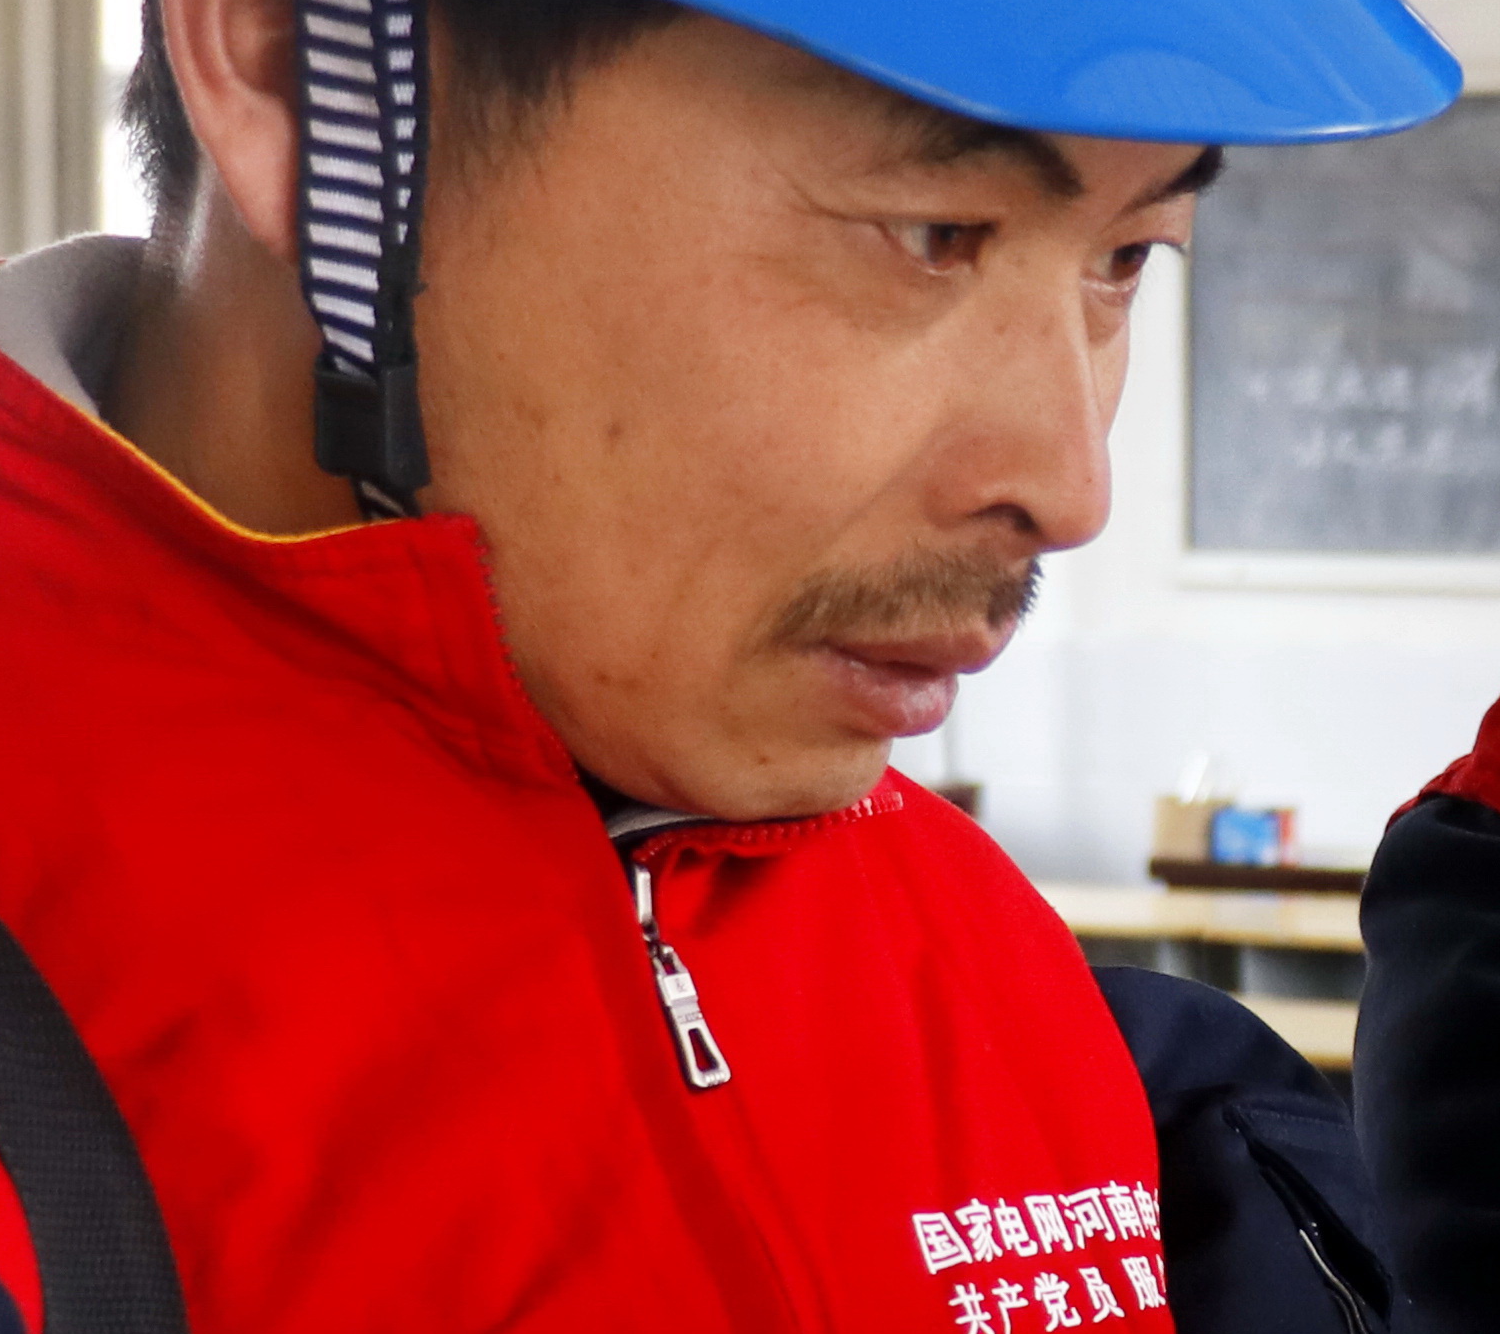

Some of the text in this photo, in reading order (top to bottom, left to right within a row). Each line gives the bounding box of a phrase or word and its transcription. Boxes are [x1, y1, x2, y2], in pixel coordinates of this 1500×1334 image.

[911, 1180, 1160, 1274] 国家电网河南电
